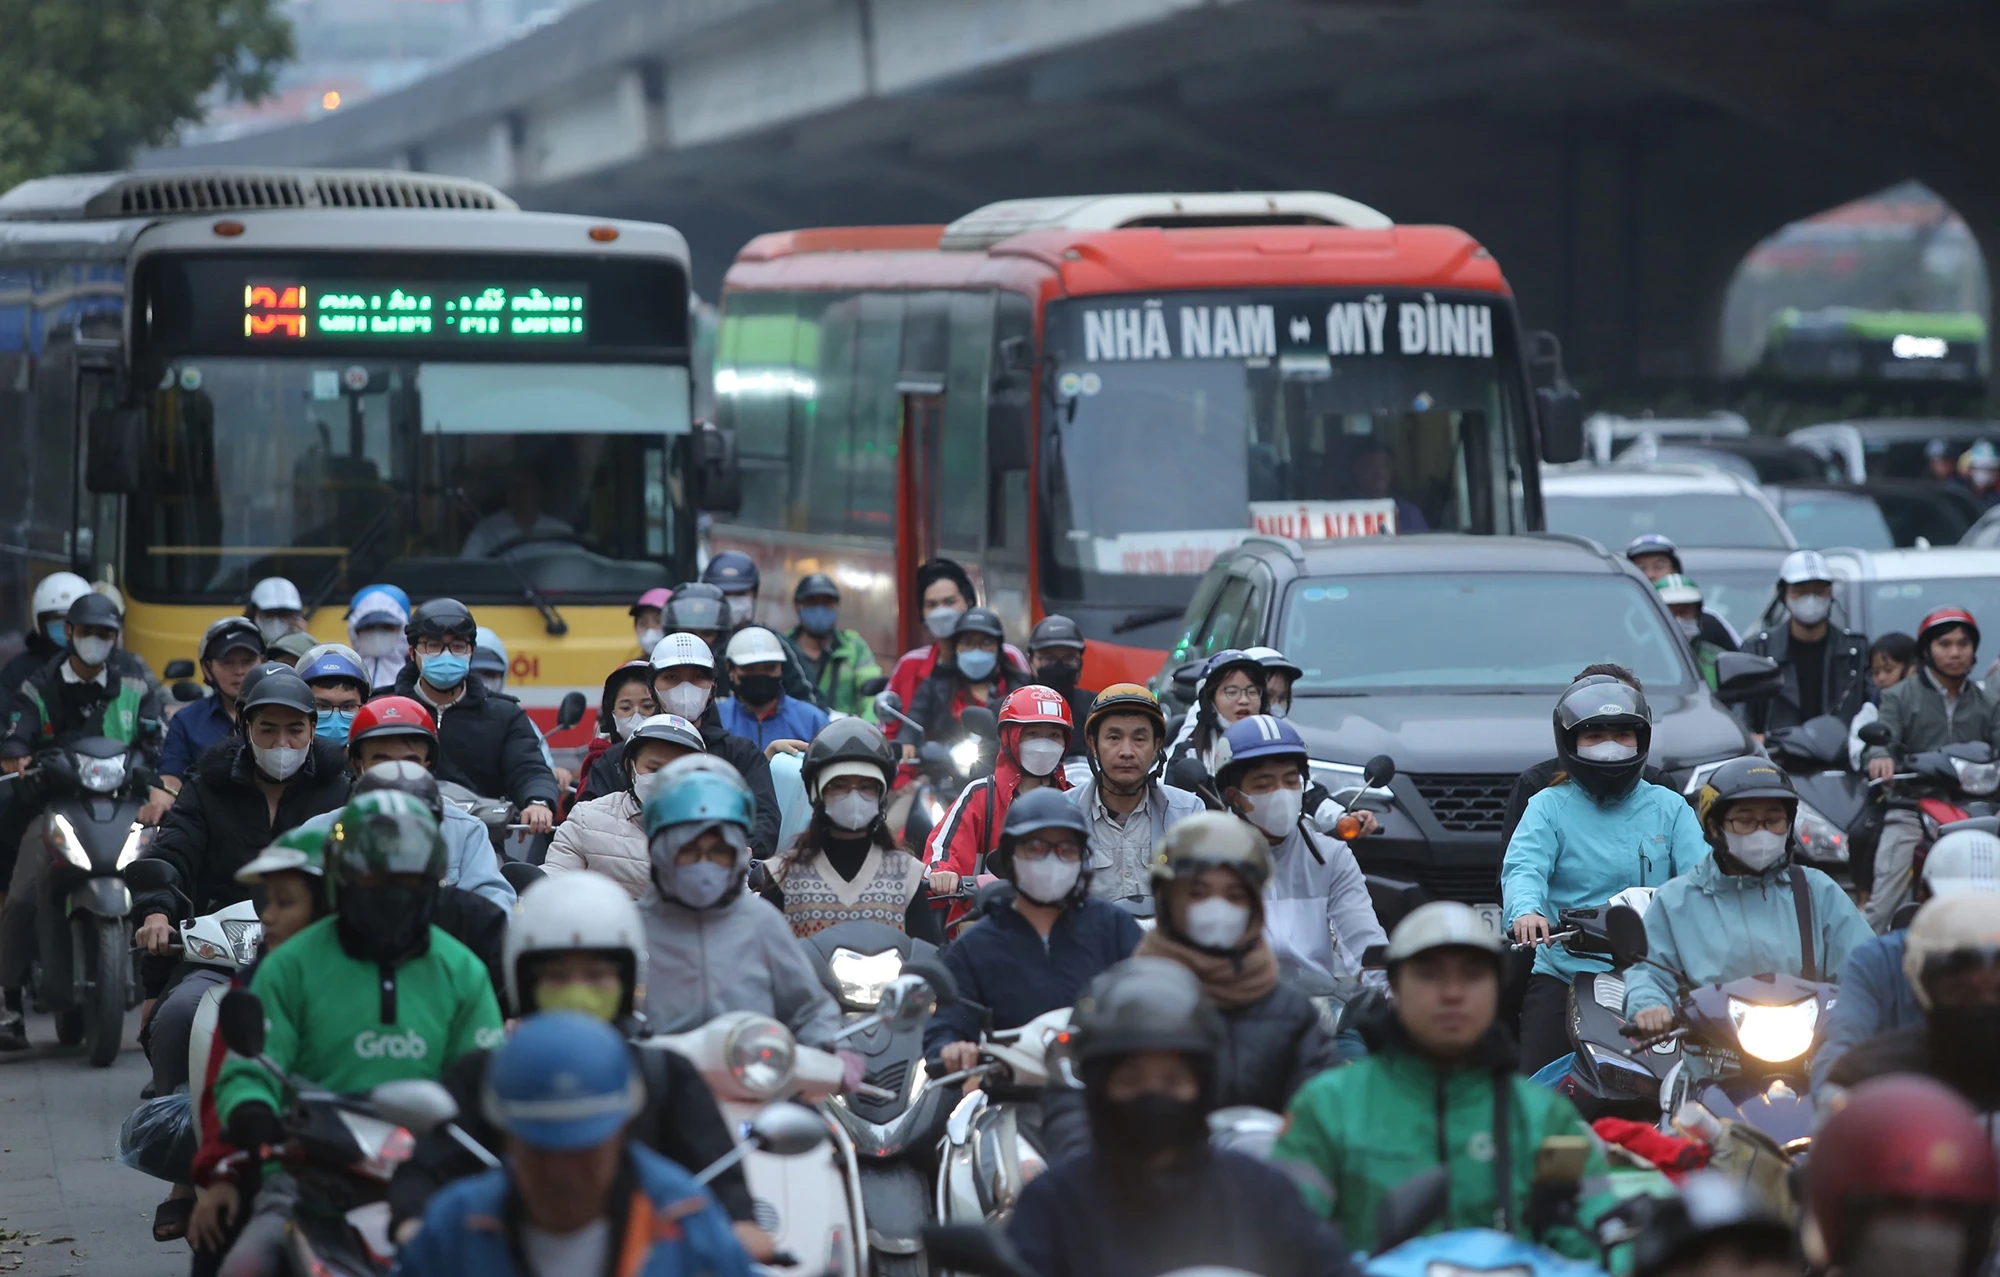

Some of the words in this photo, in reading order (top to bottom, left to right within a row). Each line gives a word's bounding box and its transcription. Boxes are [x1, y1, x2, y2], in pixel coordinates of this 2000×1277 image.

[1084, 299, 1171, 361] NHÃ
[1180, 305, 1277, 357] NAM
[1326, 295, 1387, 355] MỸ
[1400, 293, 1494, 357] ĐÌNH
[512, 652, 540, 685] ỘI
[354, 1029, 428, 1059] Grab
